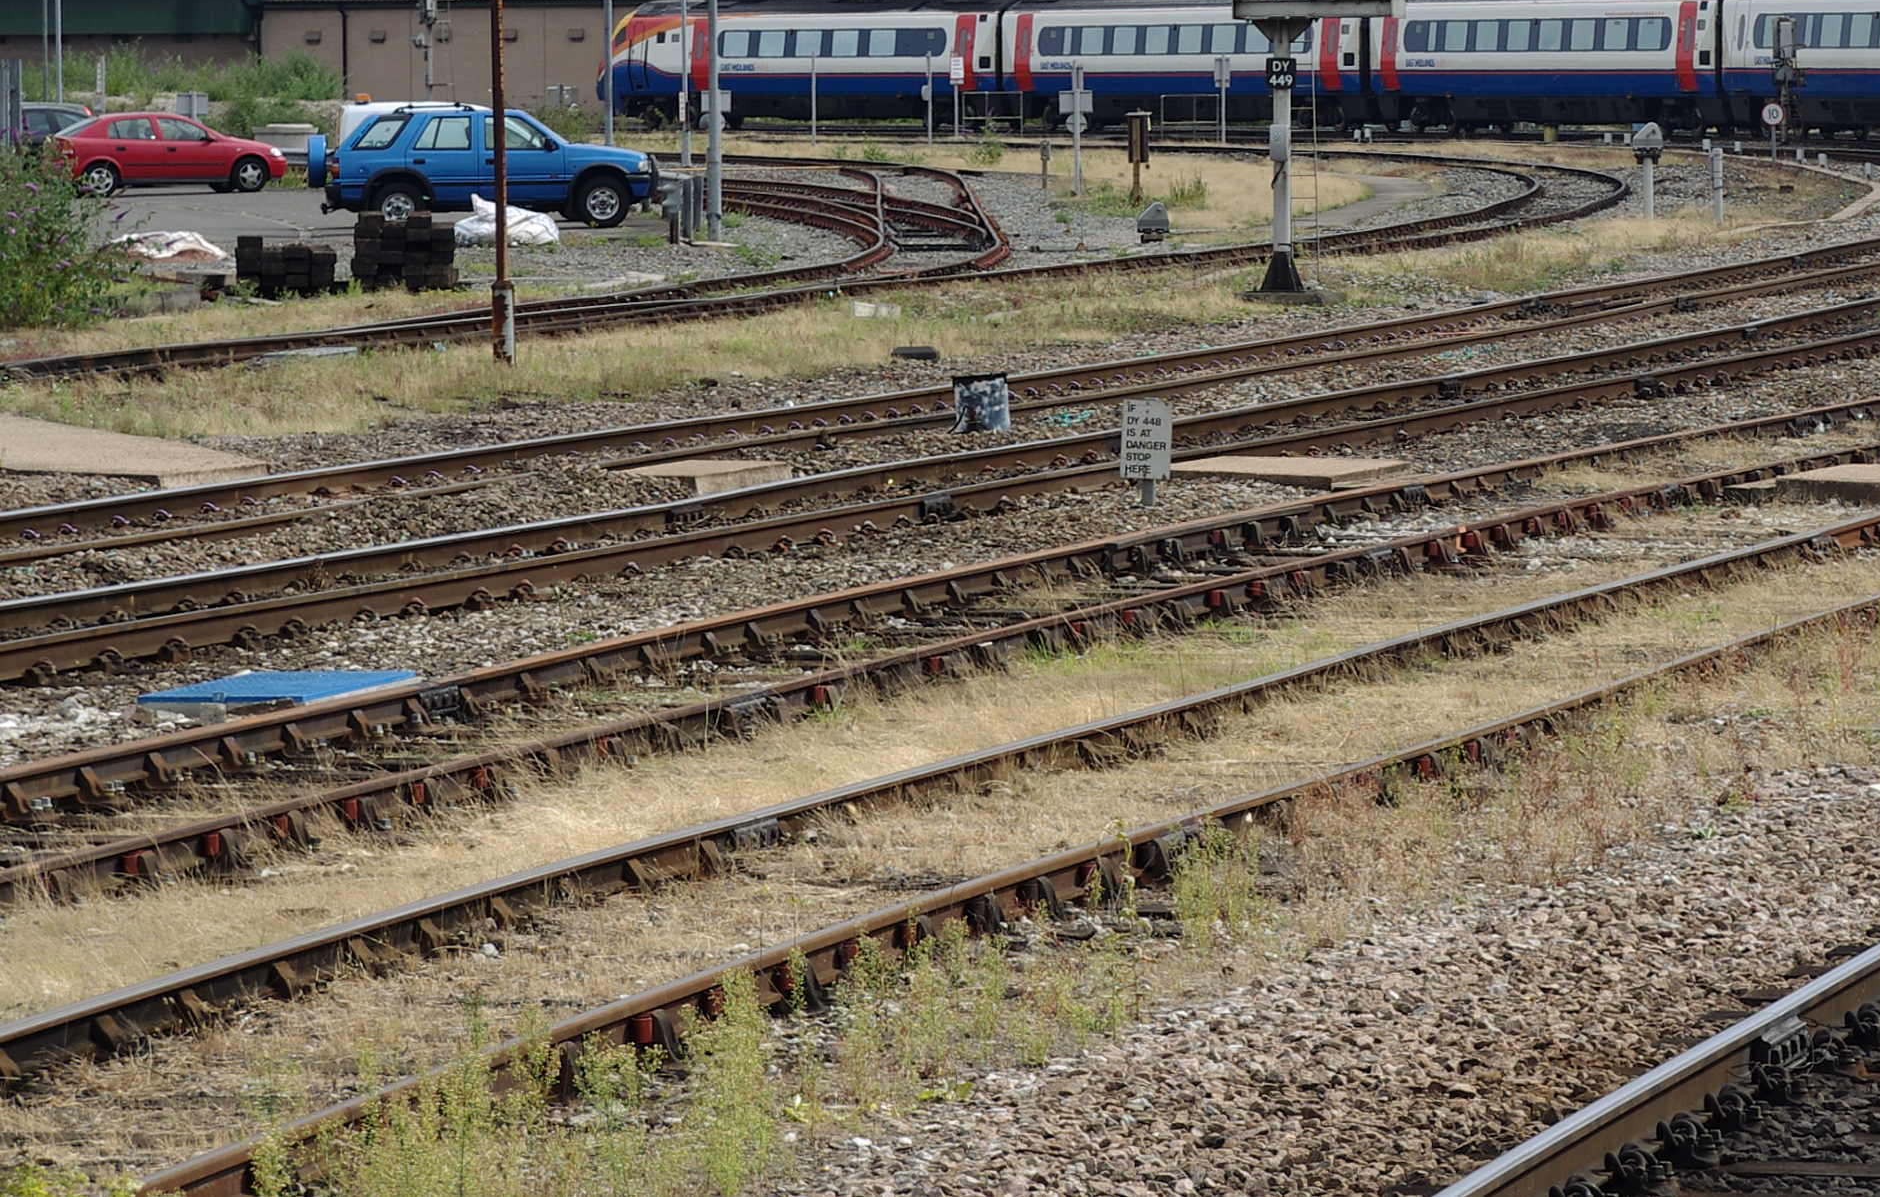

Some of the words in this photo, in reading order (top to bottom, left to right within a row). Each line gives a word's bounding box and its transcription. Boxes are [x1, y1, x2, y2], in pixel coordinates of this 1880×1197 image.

[1272, 61, 1290, 72] DY
[1269, 74, 1293, 86] 449
[1768, 108, 1779, 119] 10
[1127, 404, 1136, 412] IF
[1127, 416, 1139, 425] DY
[1143, 417, 1161, 426] 448
[1126, 428, 1136, 437] IS
[1140, 429, 1152, 437] AT
[1126, 440, 1167, 450] DANGER
[1126, 452, 1151, 462] STOP
[1125, 464, 1151, 474] HERE
